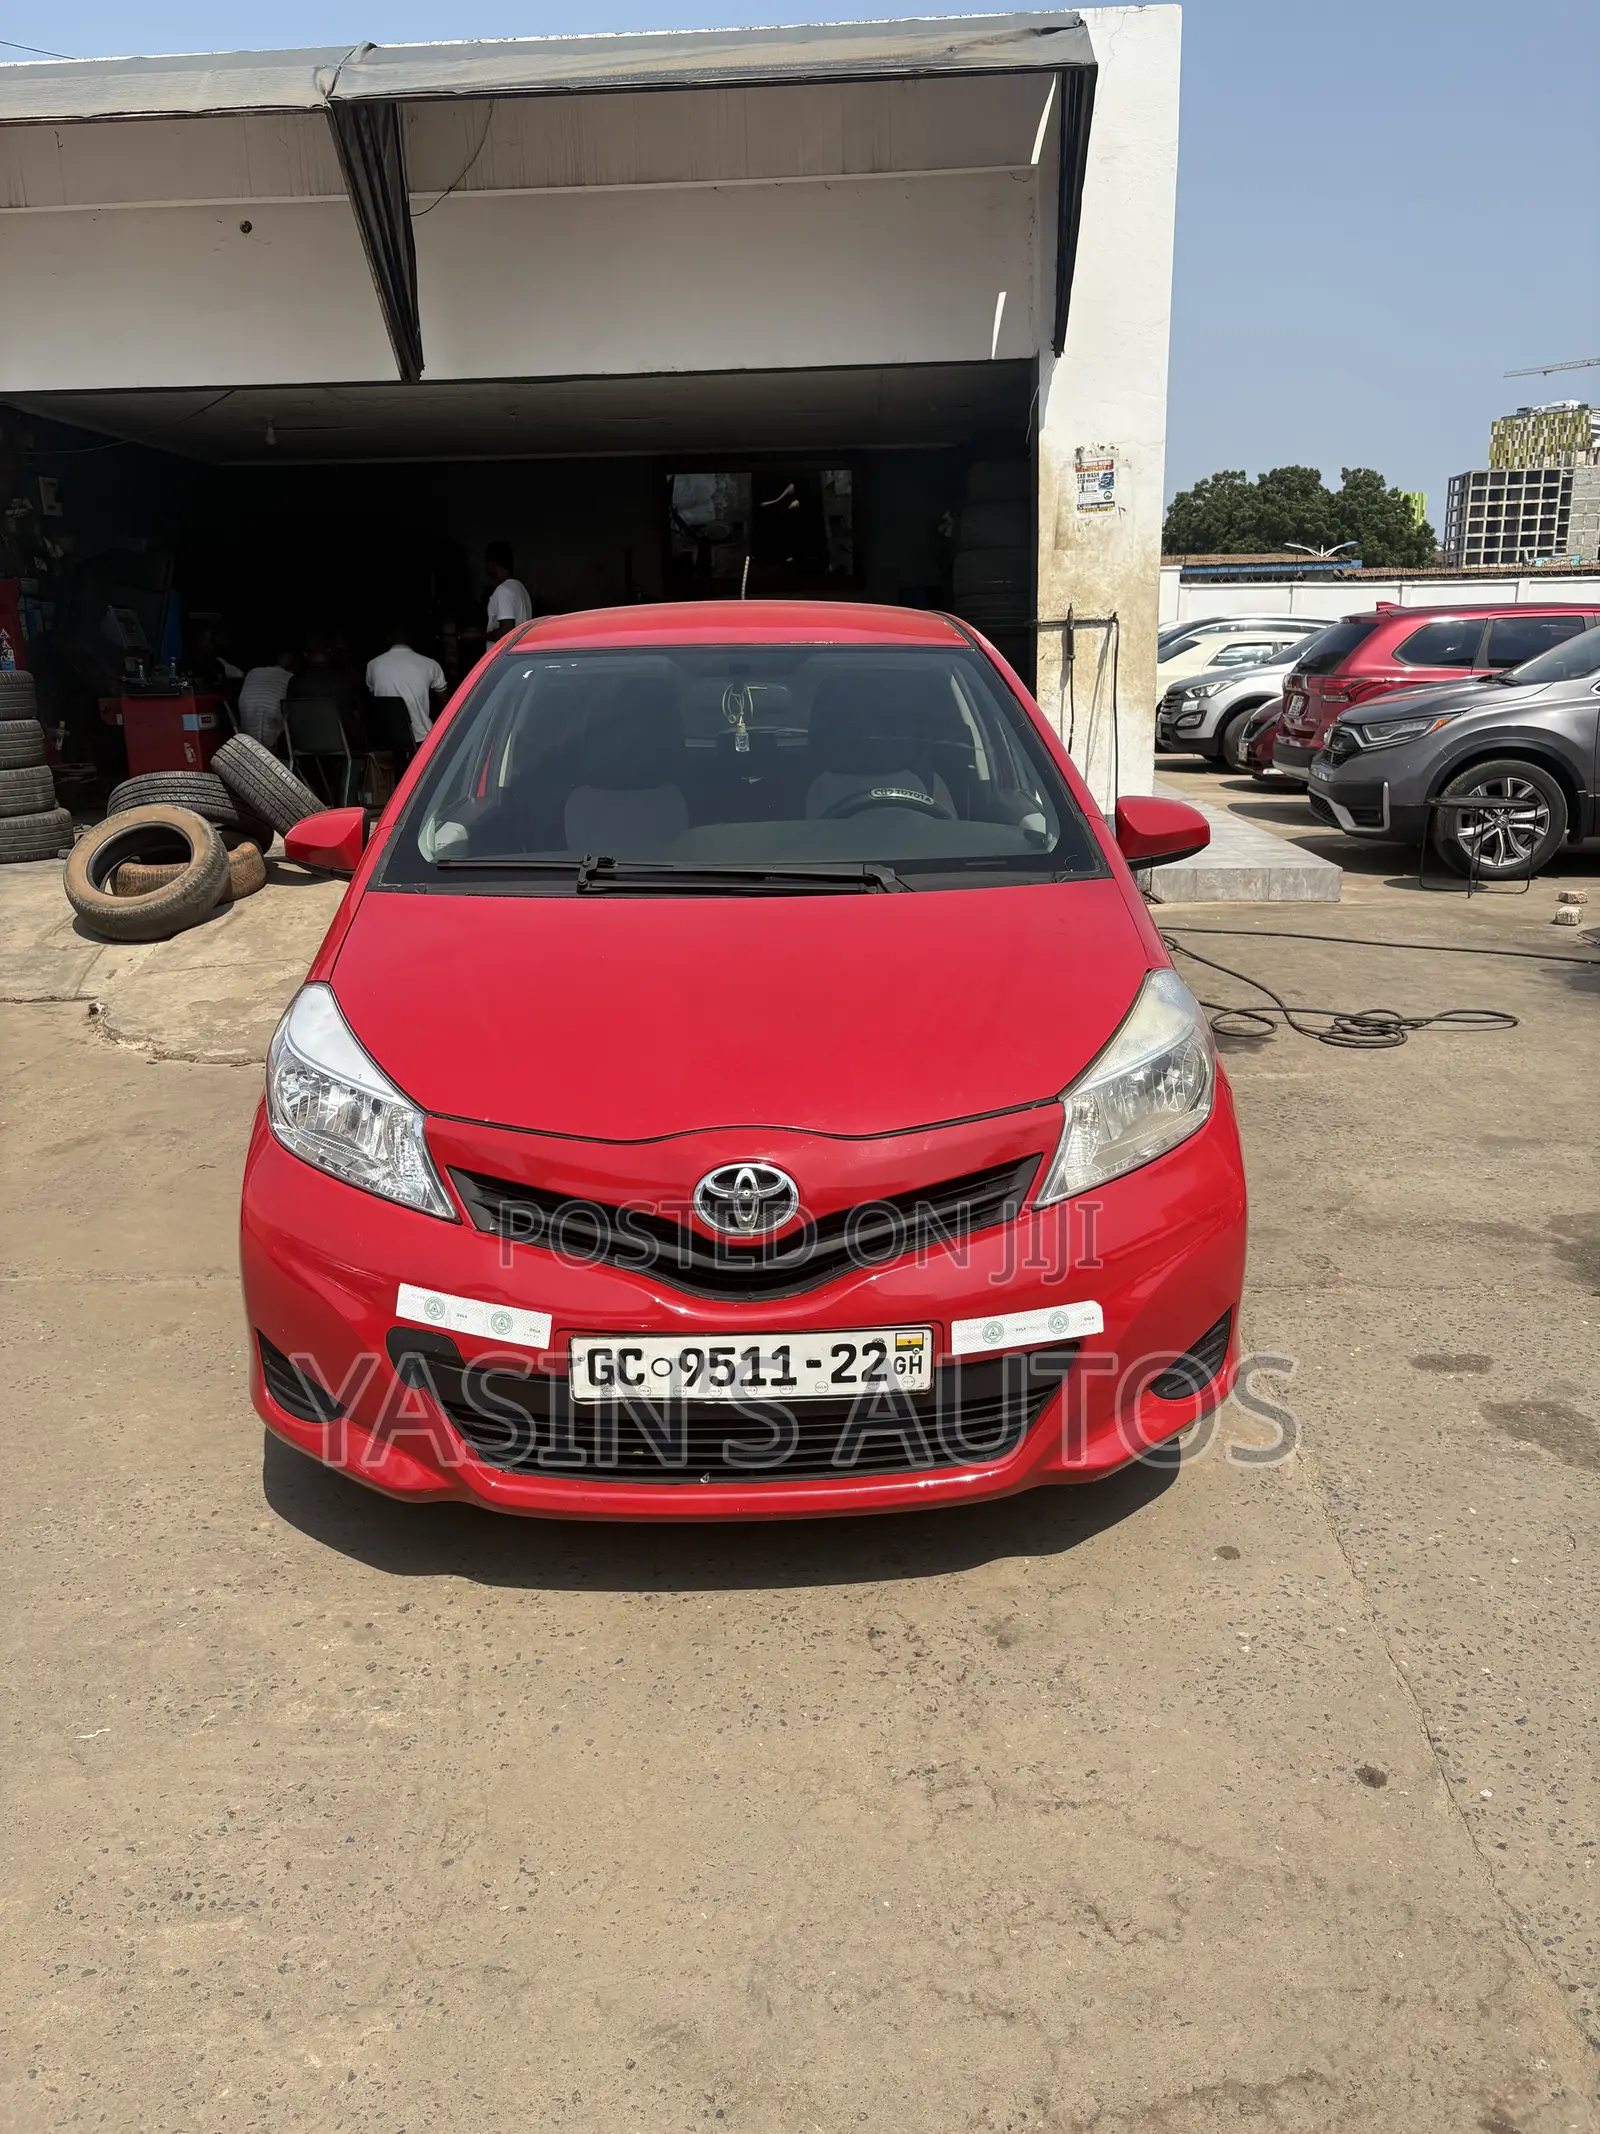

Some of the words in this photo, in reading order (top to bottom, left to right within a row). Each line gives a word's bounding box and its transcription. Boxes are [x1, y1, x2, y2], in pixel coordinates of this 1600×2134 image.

[896, 789, 931, 803] TOYOTA
[587, 1347, 646, 1388] GC
[893, 1355, 922, 1376] GH
